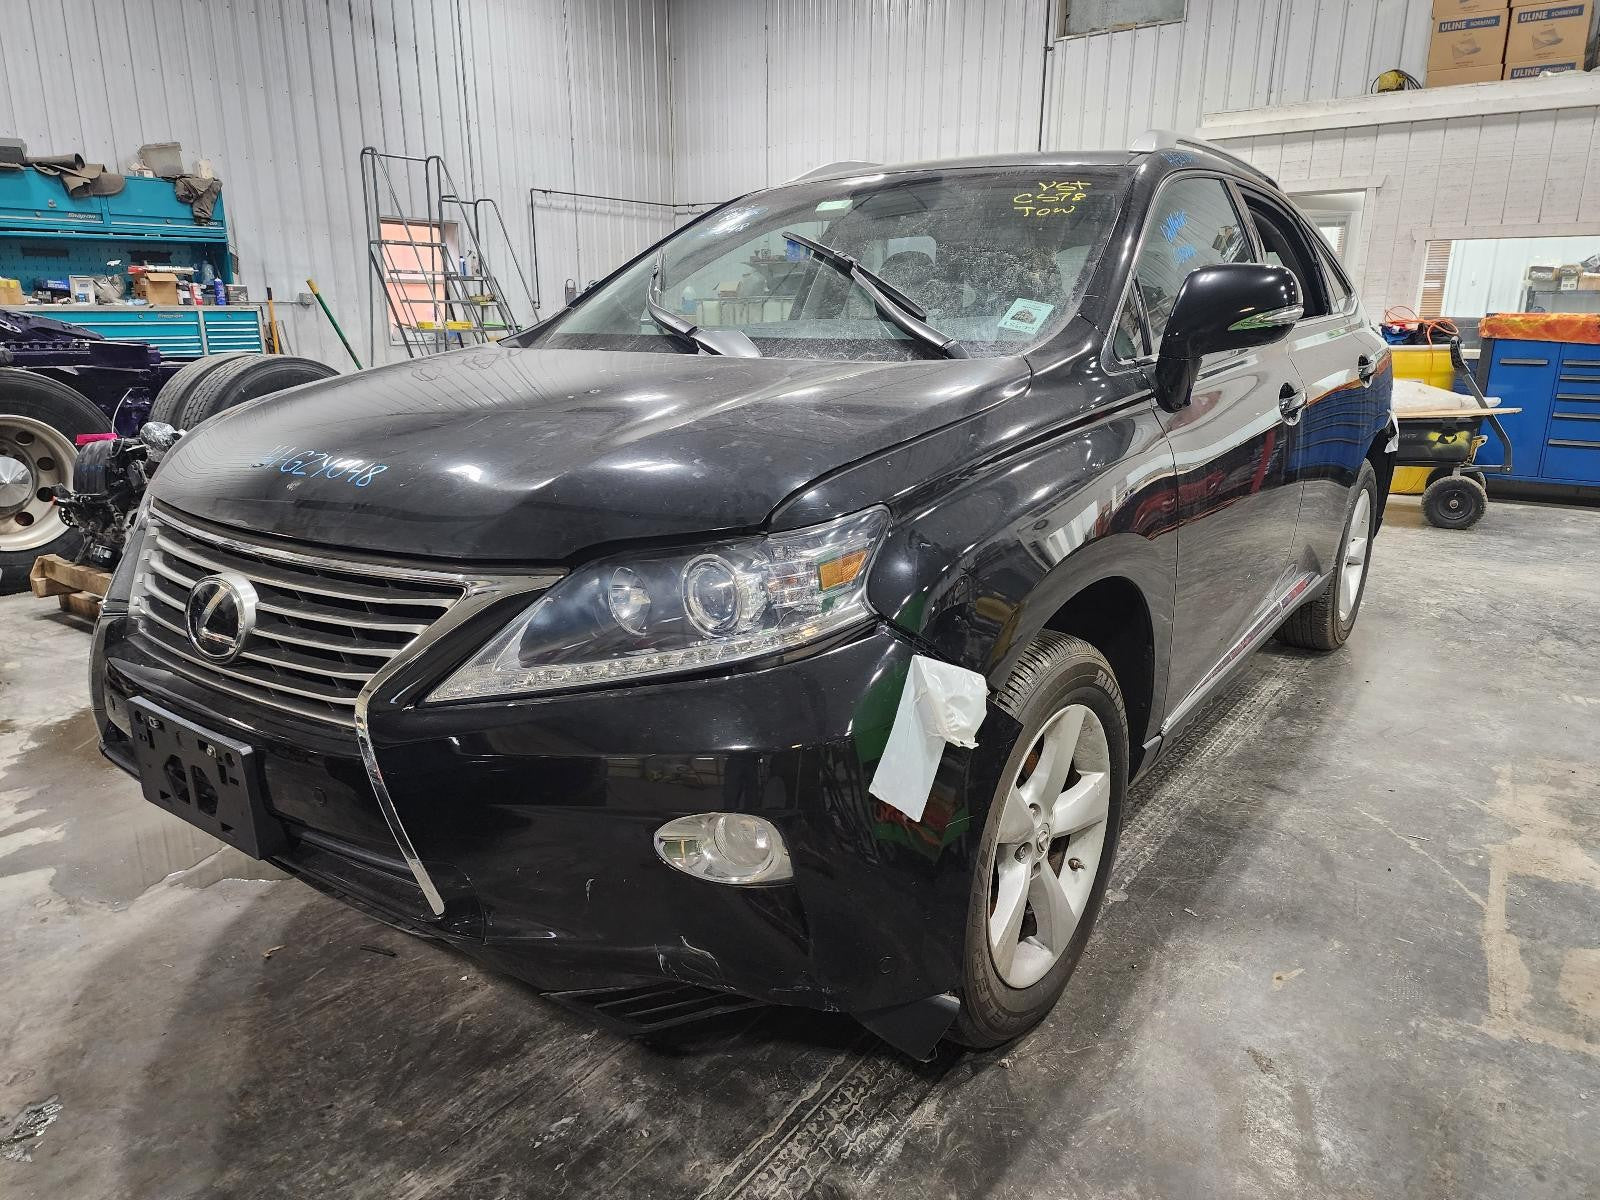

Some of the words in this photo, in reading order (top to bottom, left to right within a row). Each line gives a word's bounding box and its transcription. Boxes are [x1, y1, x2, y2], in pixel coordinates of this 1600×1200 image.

[1521, 11, 1548, 21] ULINE
[1441, 21, 1467, 31] ULINE
[1513, 67, 1540, 78] ULINE
